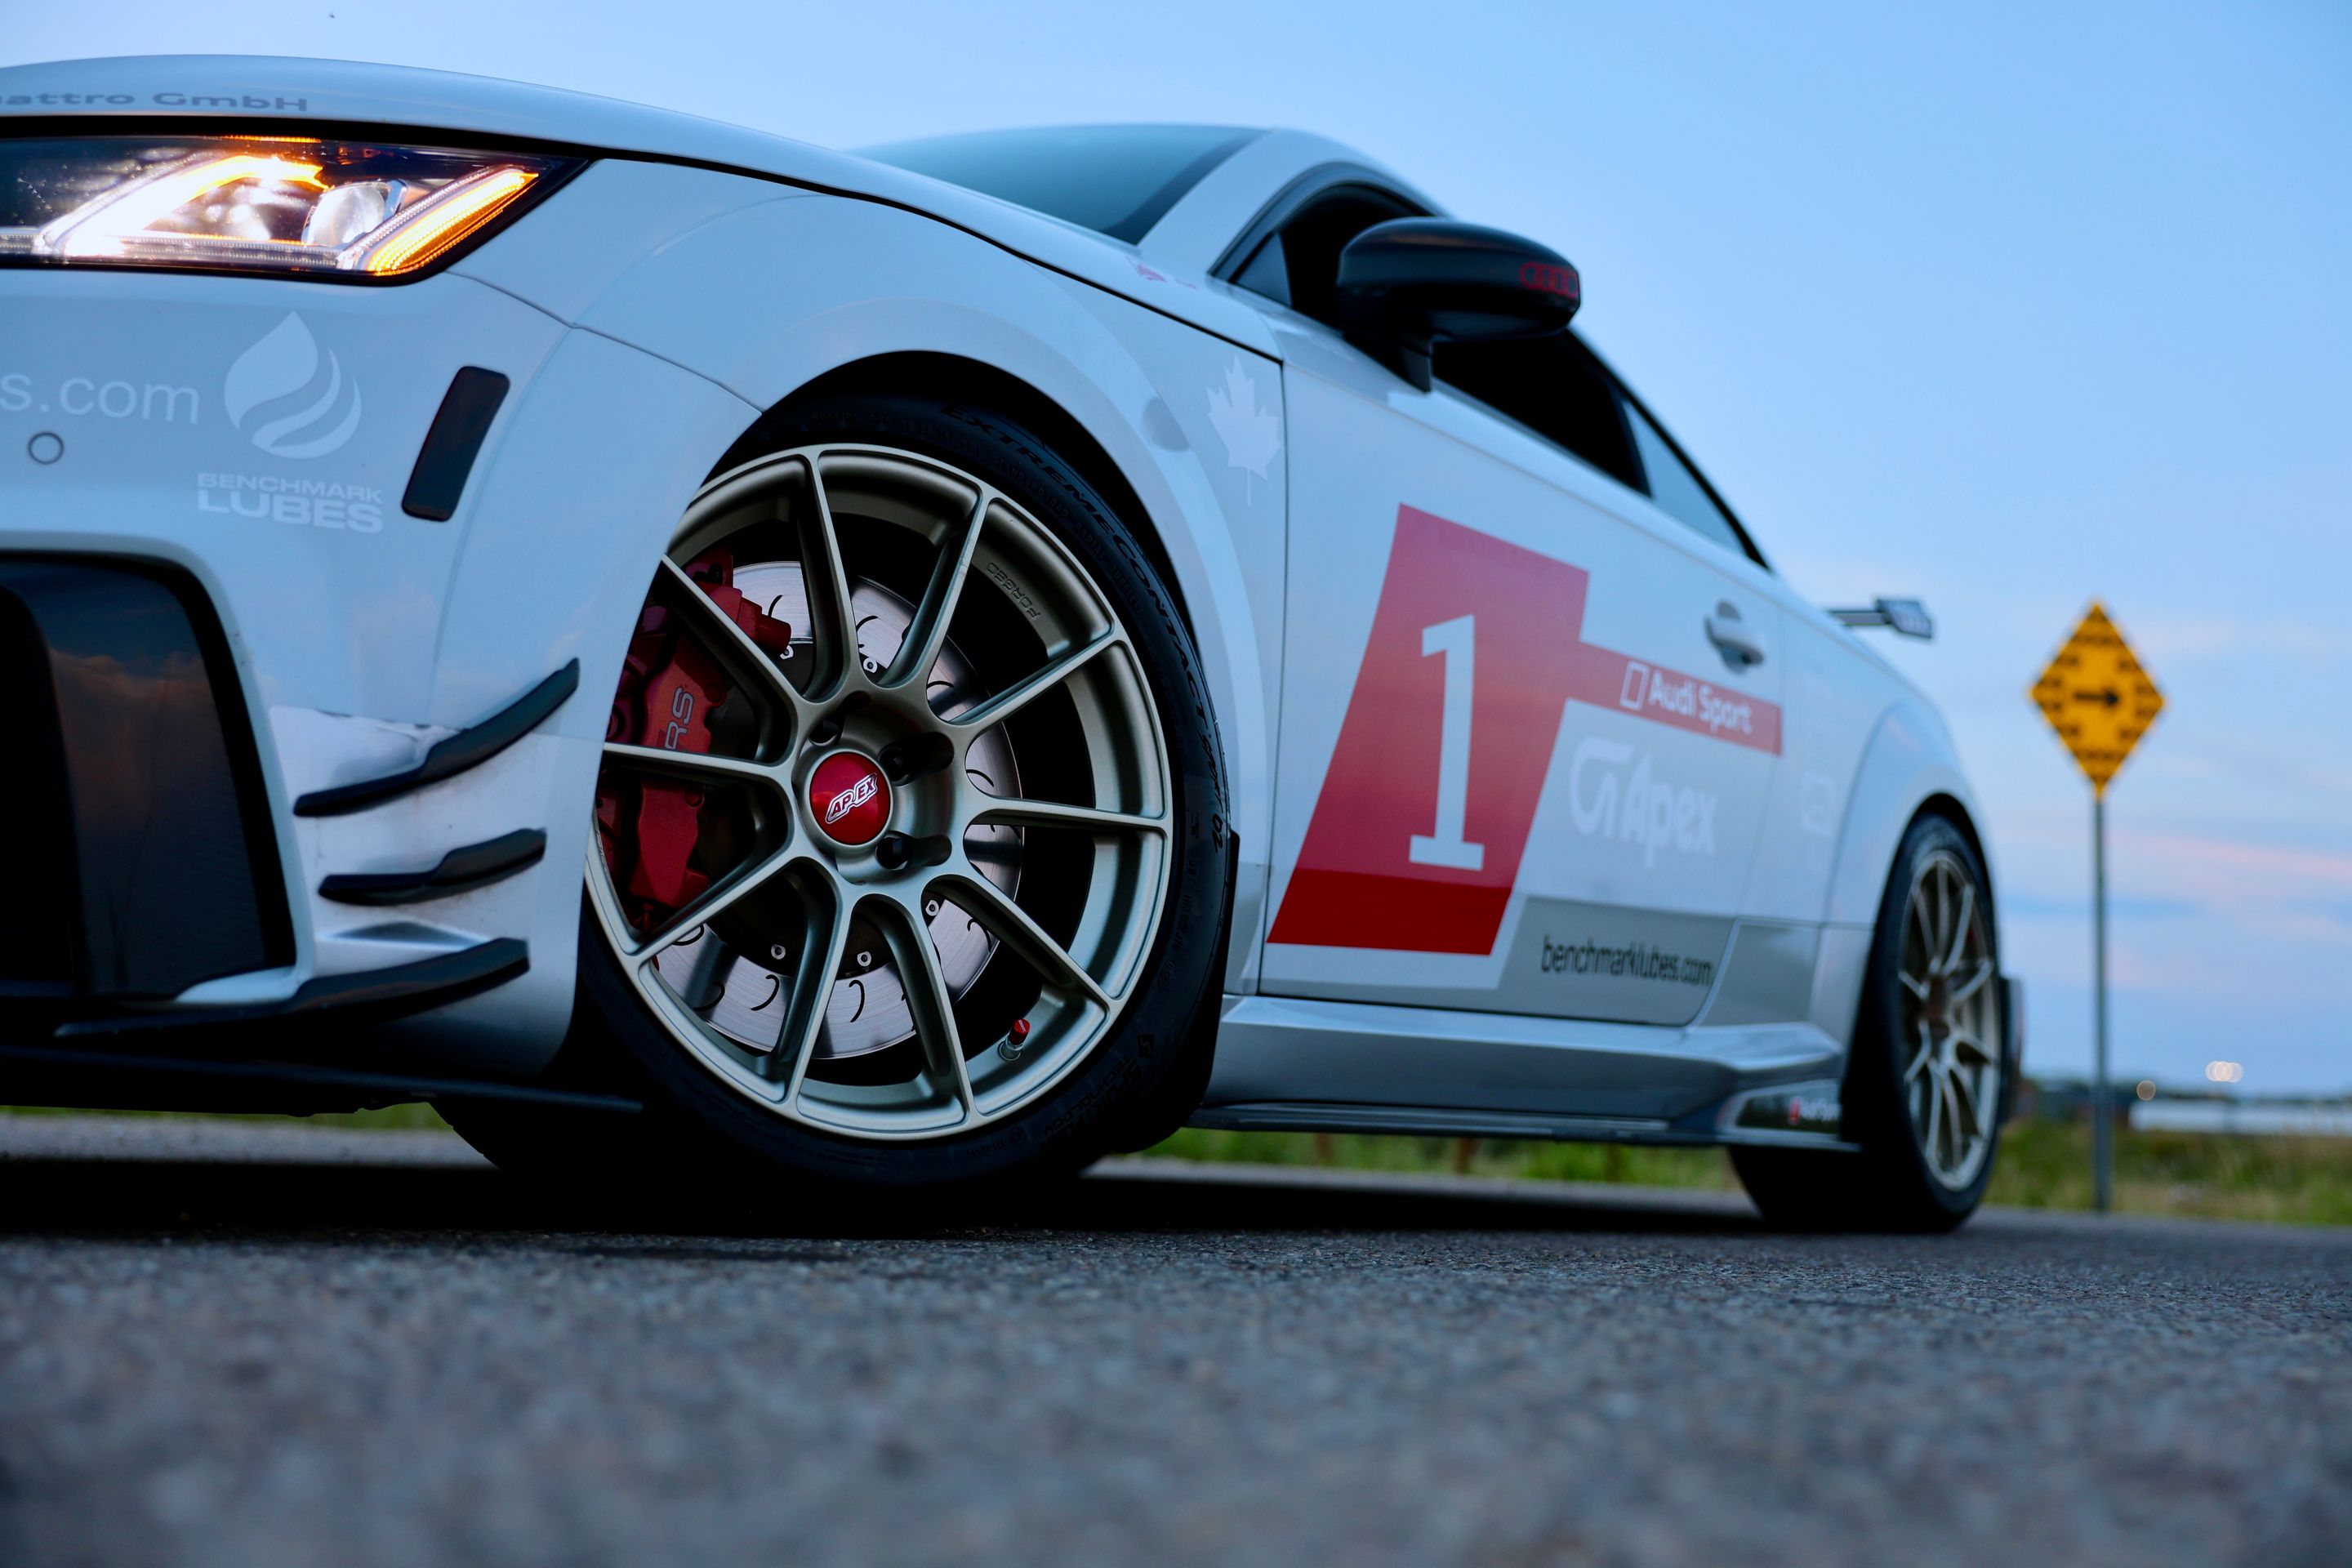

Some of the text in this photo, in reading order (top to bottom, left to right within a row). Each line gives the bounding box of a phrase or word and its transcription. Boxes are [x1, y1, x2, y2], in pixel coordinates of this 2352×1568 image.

[0, 92, 308, 112] attro GmbH
[197, 472, 383, 504] BENCHMARK
[197, 488, 384, 534] LUBES
[987, 563, 1041, 620] FORGED
[665, 687, 694, 750] RS
[1648, 669, 1753, 734] Audi Sport
[1409, 614, 1485, 871] 1
[826, 773, 877, 824] APEX
[1541, 934, 1715, 988] benchmarklubes.com
